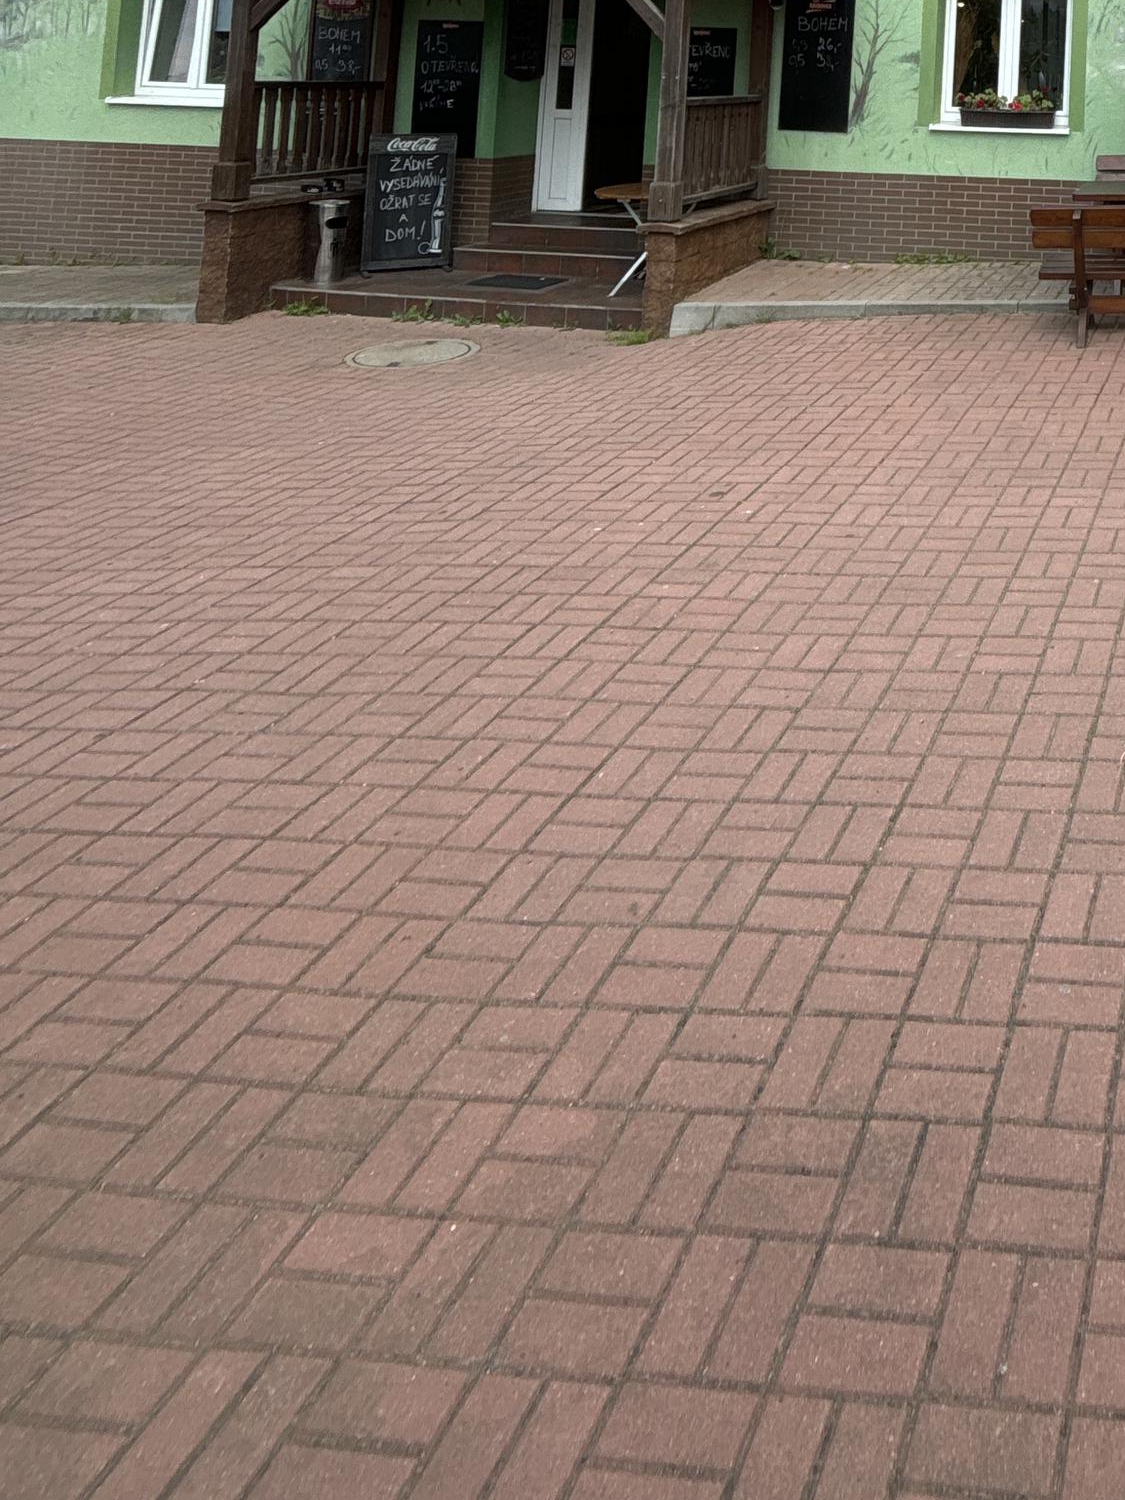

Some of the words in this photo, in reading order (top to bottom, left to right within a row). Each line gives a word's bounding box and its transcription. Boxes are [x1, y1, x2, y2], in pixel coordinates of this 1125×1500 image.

[389, 155, 440, 173] ŽÁDNÉ
[379, 194, 416, 211] OŽRAT
[417, 193, 432, 206] SE
[398, 213, 409, 224] A
